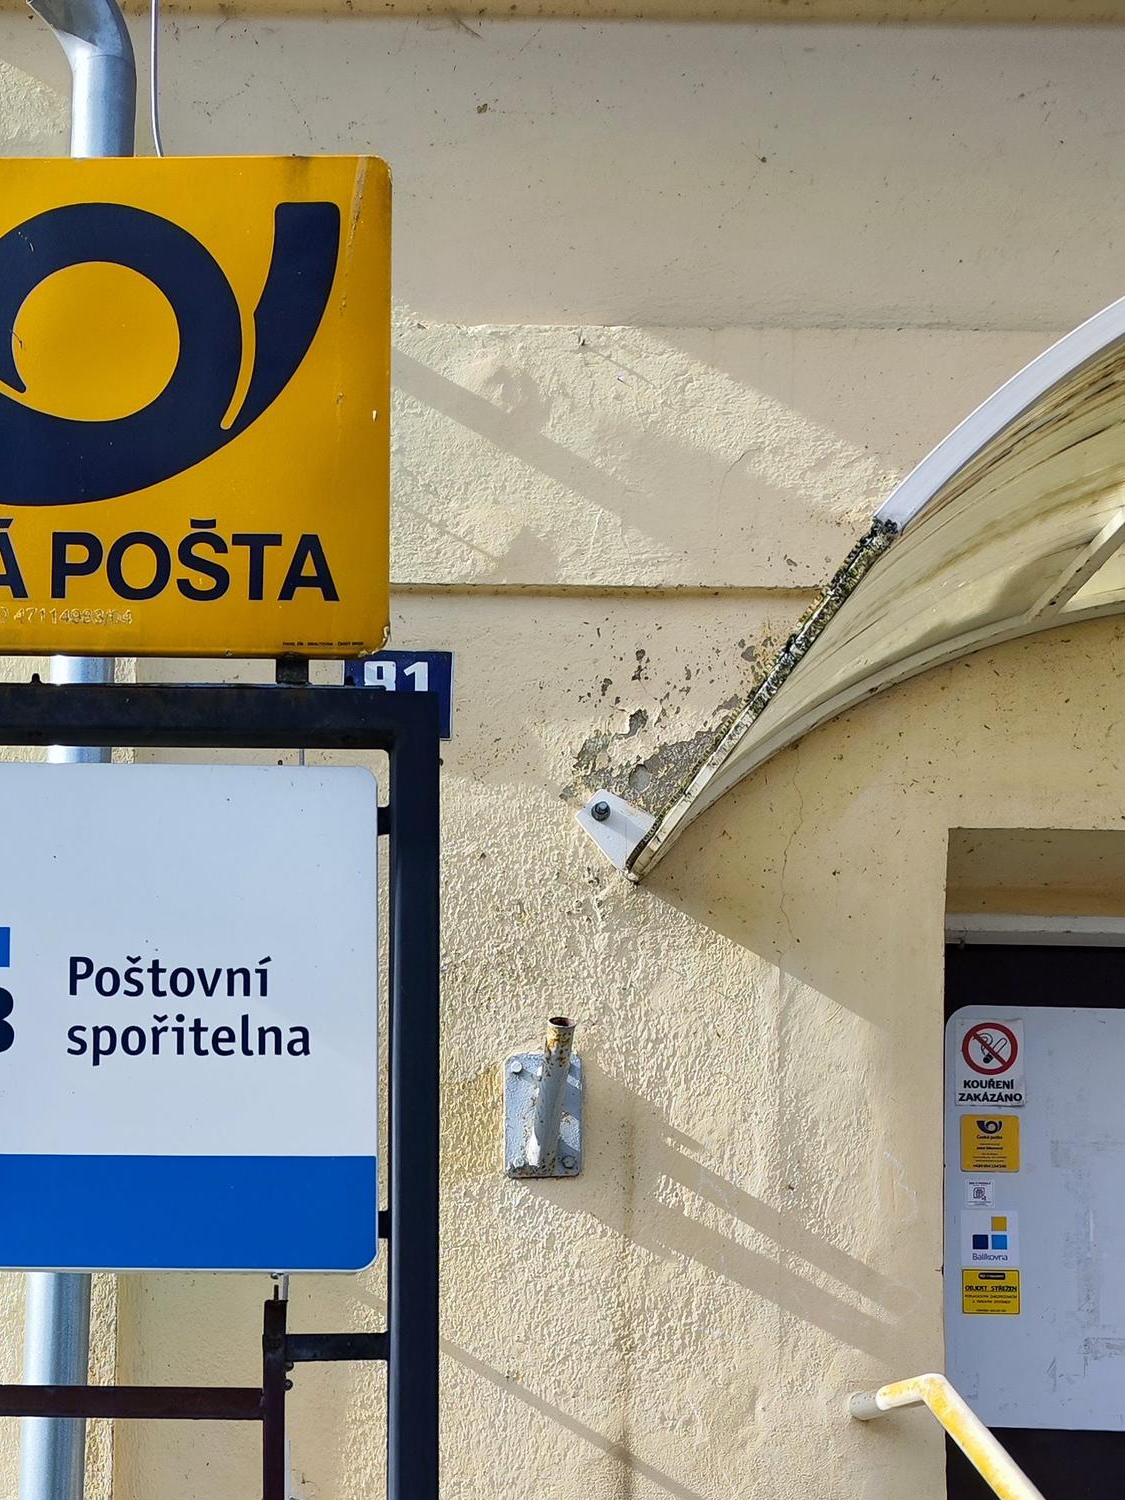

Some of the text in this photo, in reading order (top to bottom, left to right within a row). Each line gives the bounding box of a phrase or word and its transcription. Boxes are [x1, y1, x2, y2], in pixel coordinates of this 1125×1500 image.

[51, 519, 340, 602] POŠTA
[68, 955, 272, 998] Poštovní
[66, 1014, 312, 1066] spořitelna
[958, 1091, 1023, 1103] ZAKÁZÁNO
[963, 1078, 1015, 1090] KOUŘENÍ
